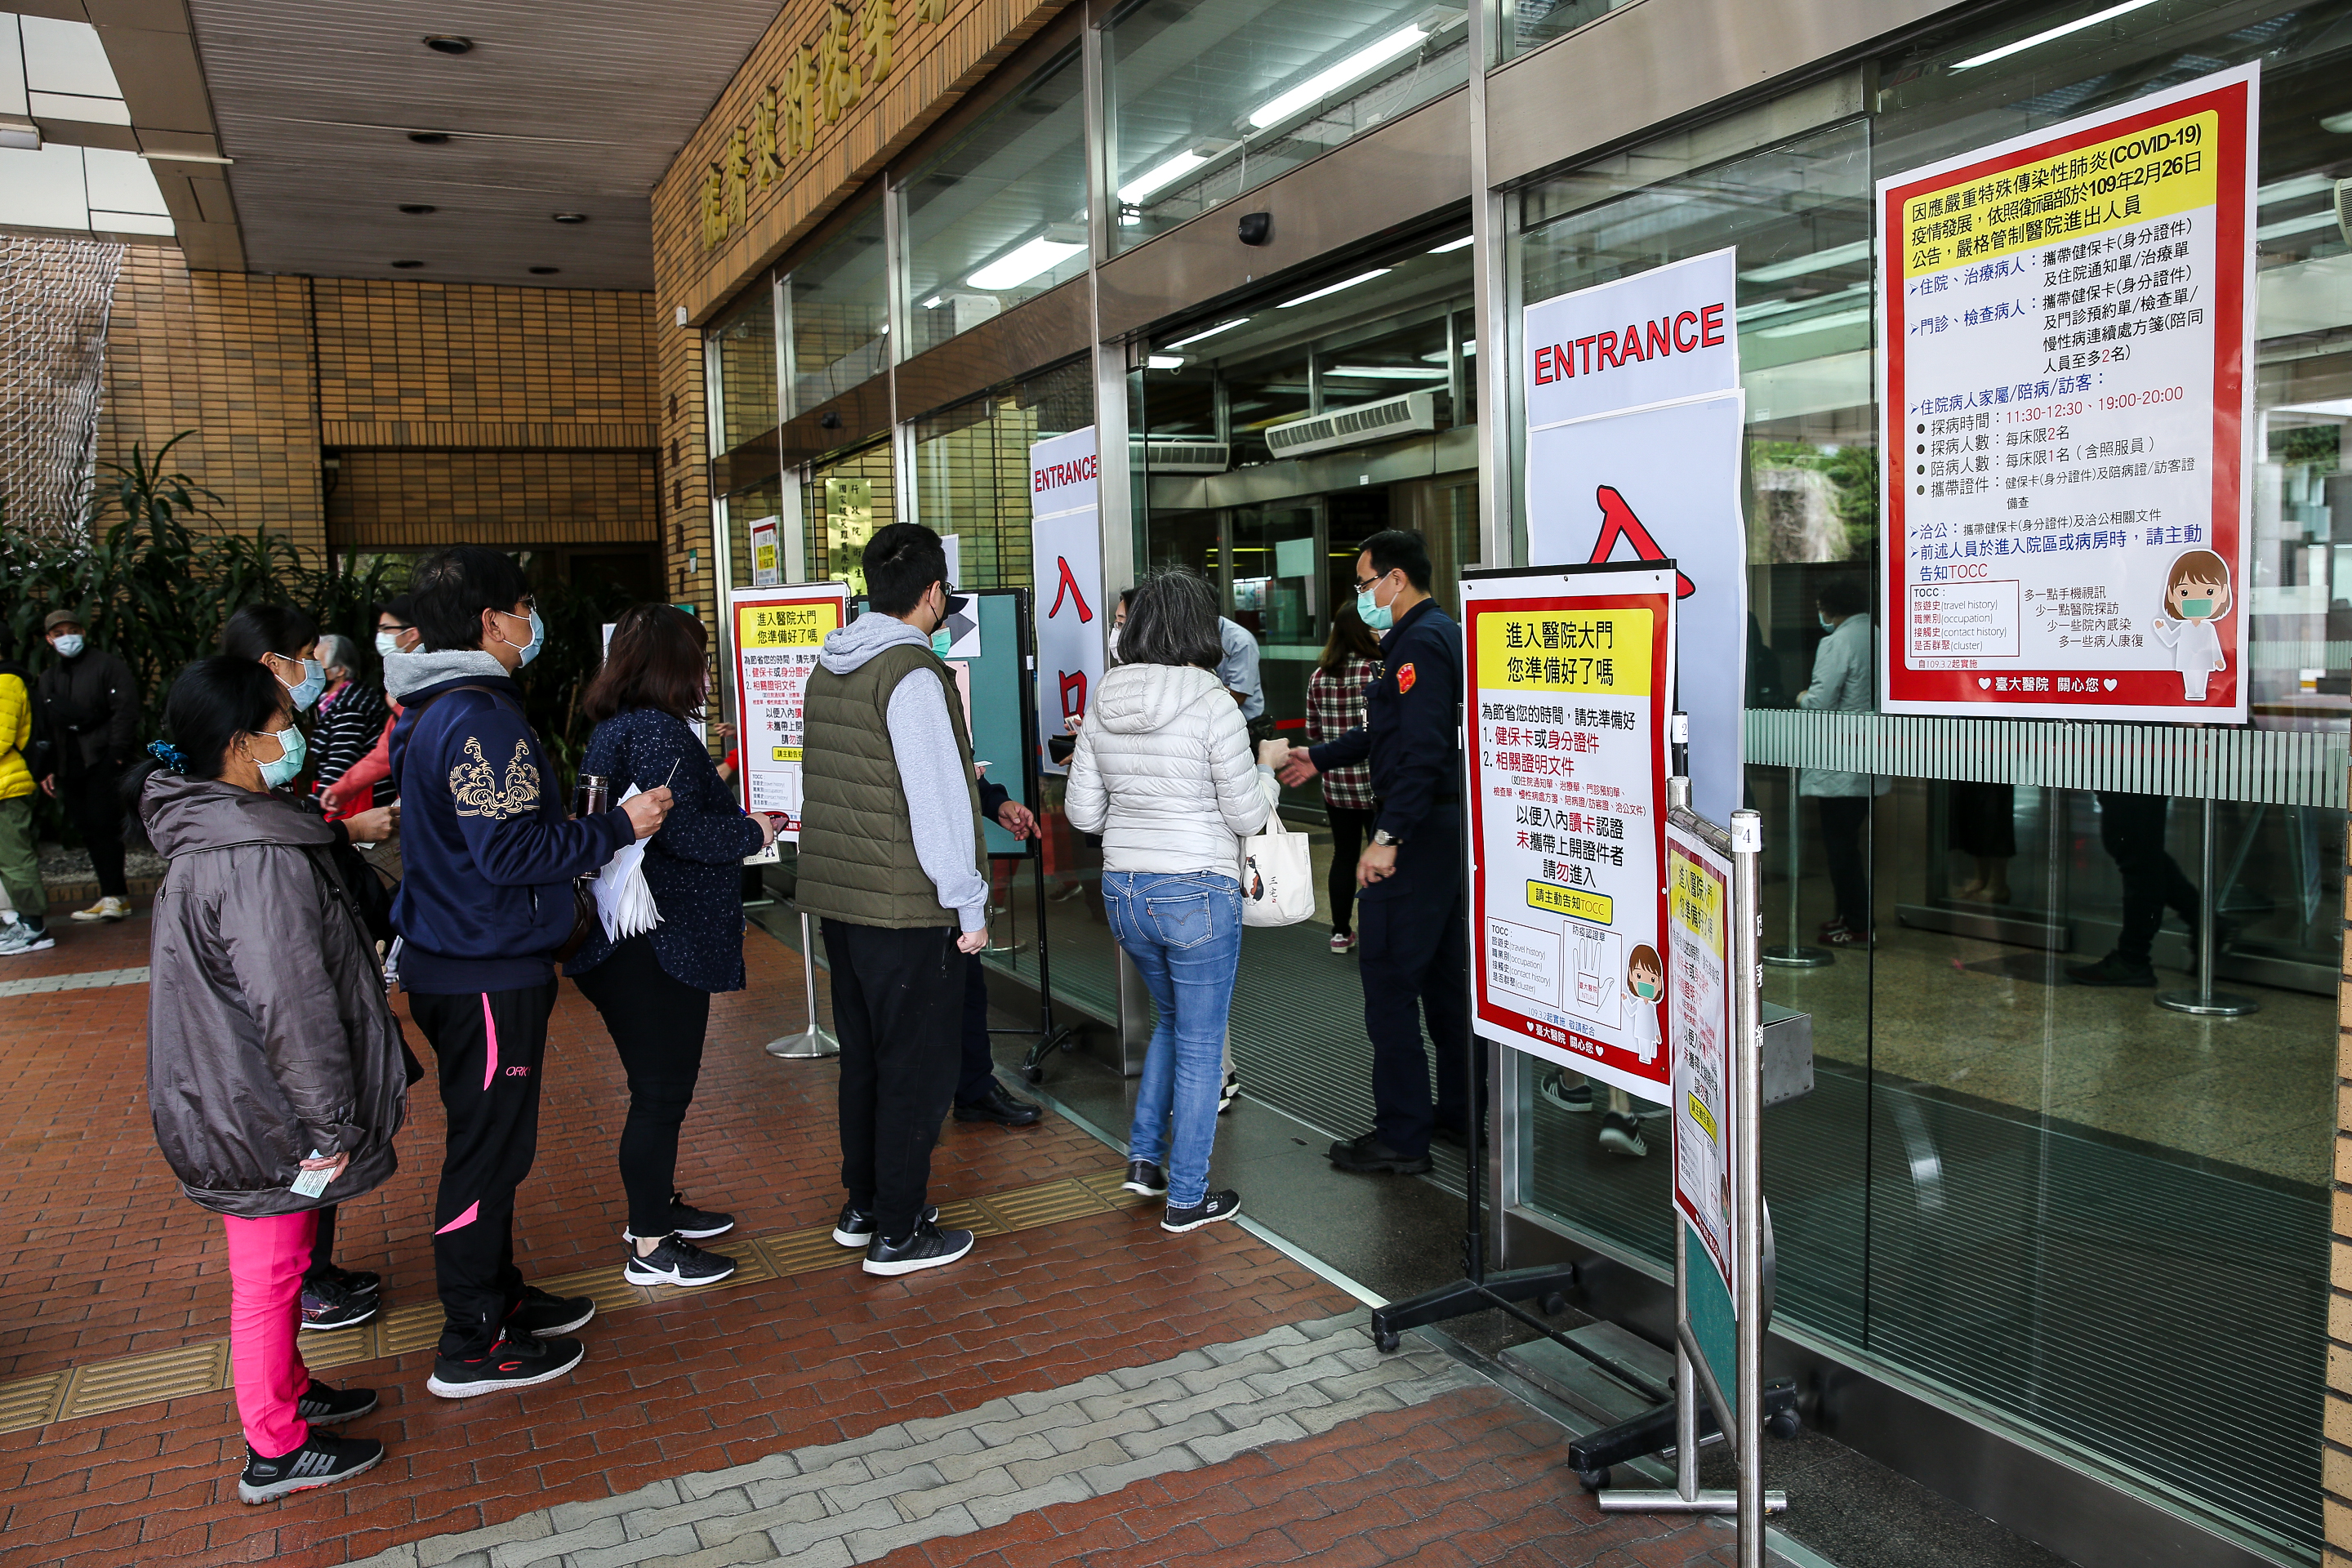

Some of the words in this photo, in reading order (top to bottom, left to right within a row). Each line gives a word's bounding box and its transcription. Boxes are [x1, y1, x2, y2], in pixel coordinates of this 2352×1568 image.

[1913, 194, 2142, 270] 公告，嚴格管制醫院進出人員
[2043, 240, 2189, 287] 及住院通知單/治療單
[2043, 285, 2198, 331] 及門診預約單/檢查單/
[2042, 308, 2204, 353] 慢性病連續處方箋(陪同
[1535, 302, 1726, 387] ENTRANCE
[2042, 344, 2132, 375] 人員至多2名)
[2006, 425, 2069, 447] 每床限2名
[1035, 453, 1098, 492] ENTRANCE
[2007, 496, 2029, 510] 備查
[1920, 523, 2202, 561] 前述人員於進入院區或病房時，請主動
[1920, 564, 1988, 582] 告知TOCC
[1967, 599, 1998, 611] history)
[2024, 586, 2107, 601] 多一點手機視訊
[757, 610, 817, 626] 進入醫院大門
[2035, 601, 2119, 617] 少一點醫院探訪
[757, 628, 817, 644] 您準備好了嗎
[1506, 620, 1614, 650] 進入醫院大門
[1976, 626, 2007, 639] history)
[2047, 617, 2132, 633] 少一些院內感染
[2059, 634, 2144, 648] 多一些病人康復
[1506, 656, 1614, 687] 您準備好了嗎
[1994, 676, 2049, 692] 臺大醫院
[2057, 677, 2100, 693] 關心您
[765, 707, 803, 719] 以便入內讀
[1481, 702, 1636, 731] 為節省您的時間，請先準備好
[1483, 726, 1492, 743] 1.
[1494, 726, 1600, 755] 健保卡或身分證件
[1682, 724, 1688, 736] 2
[1483, 751, 1493, 767] 2.
[1495, 751, 1575, 777] 相關證明文件
[1516, 804, 1624, 840] 以便入內讀卡認證
[1517, 829, 1624, 867] 未攜帶上開證件者
[1742, 828, 1752, 844] 4
[1543, 858, 1597, 888] 請勿進入
[1535, 888, 1605, 915] 請主動告知TOCC
